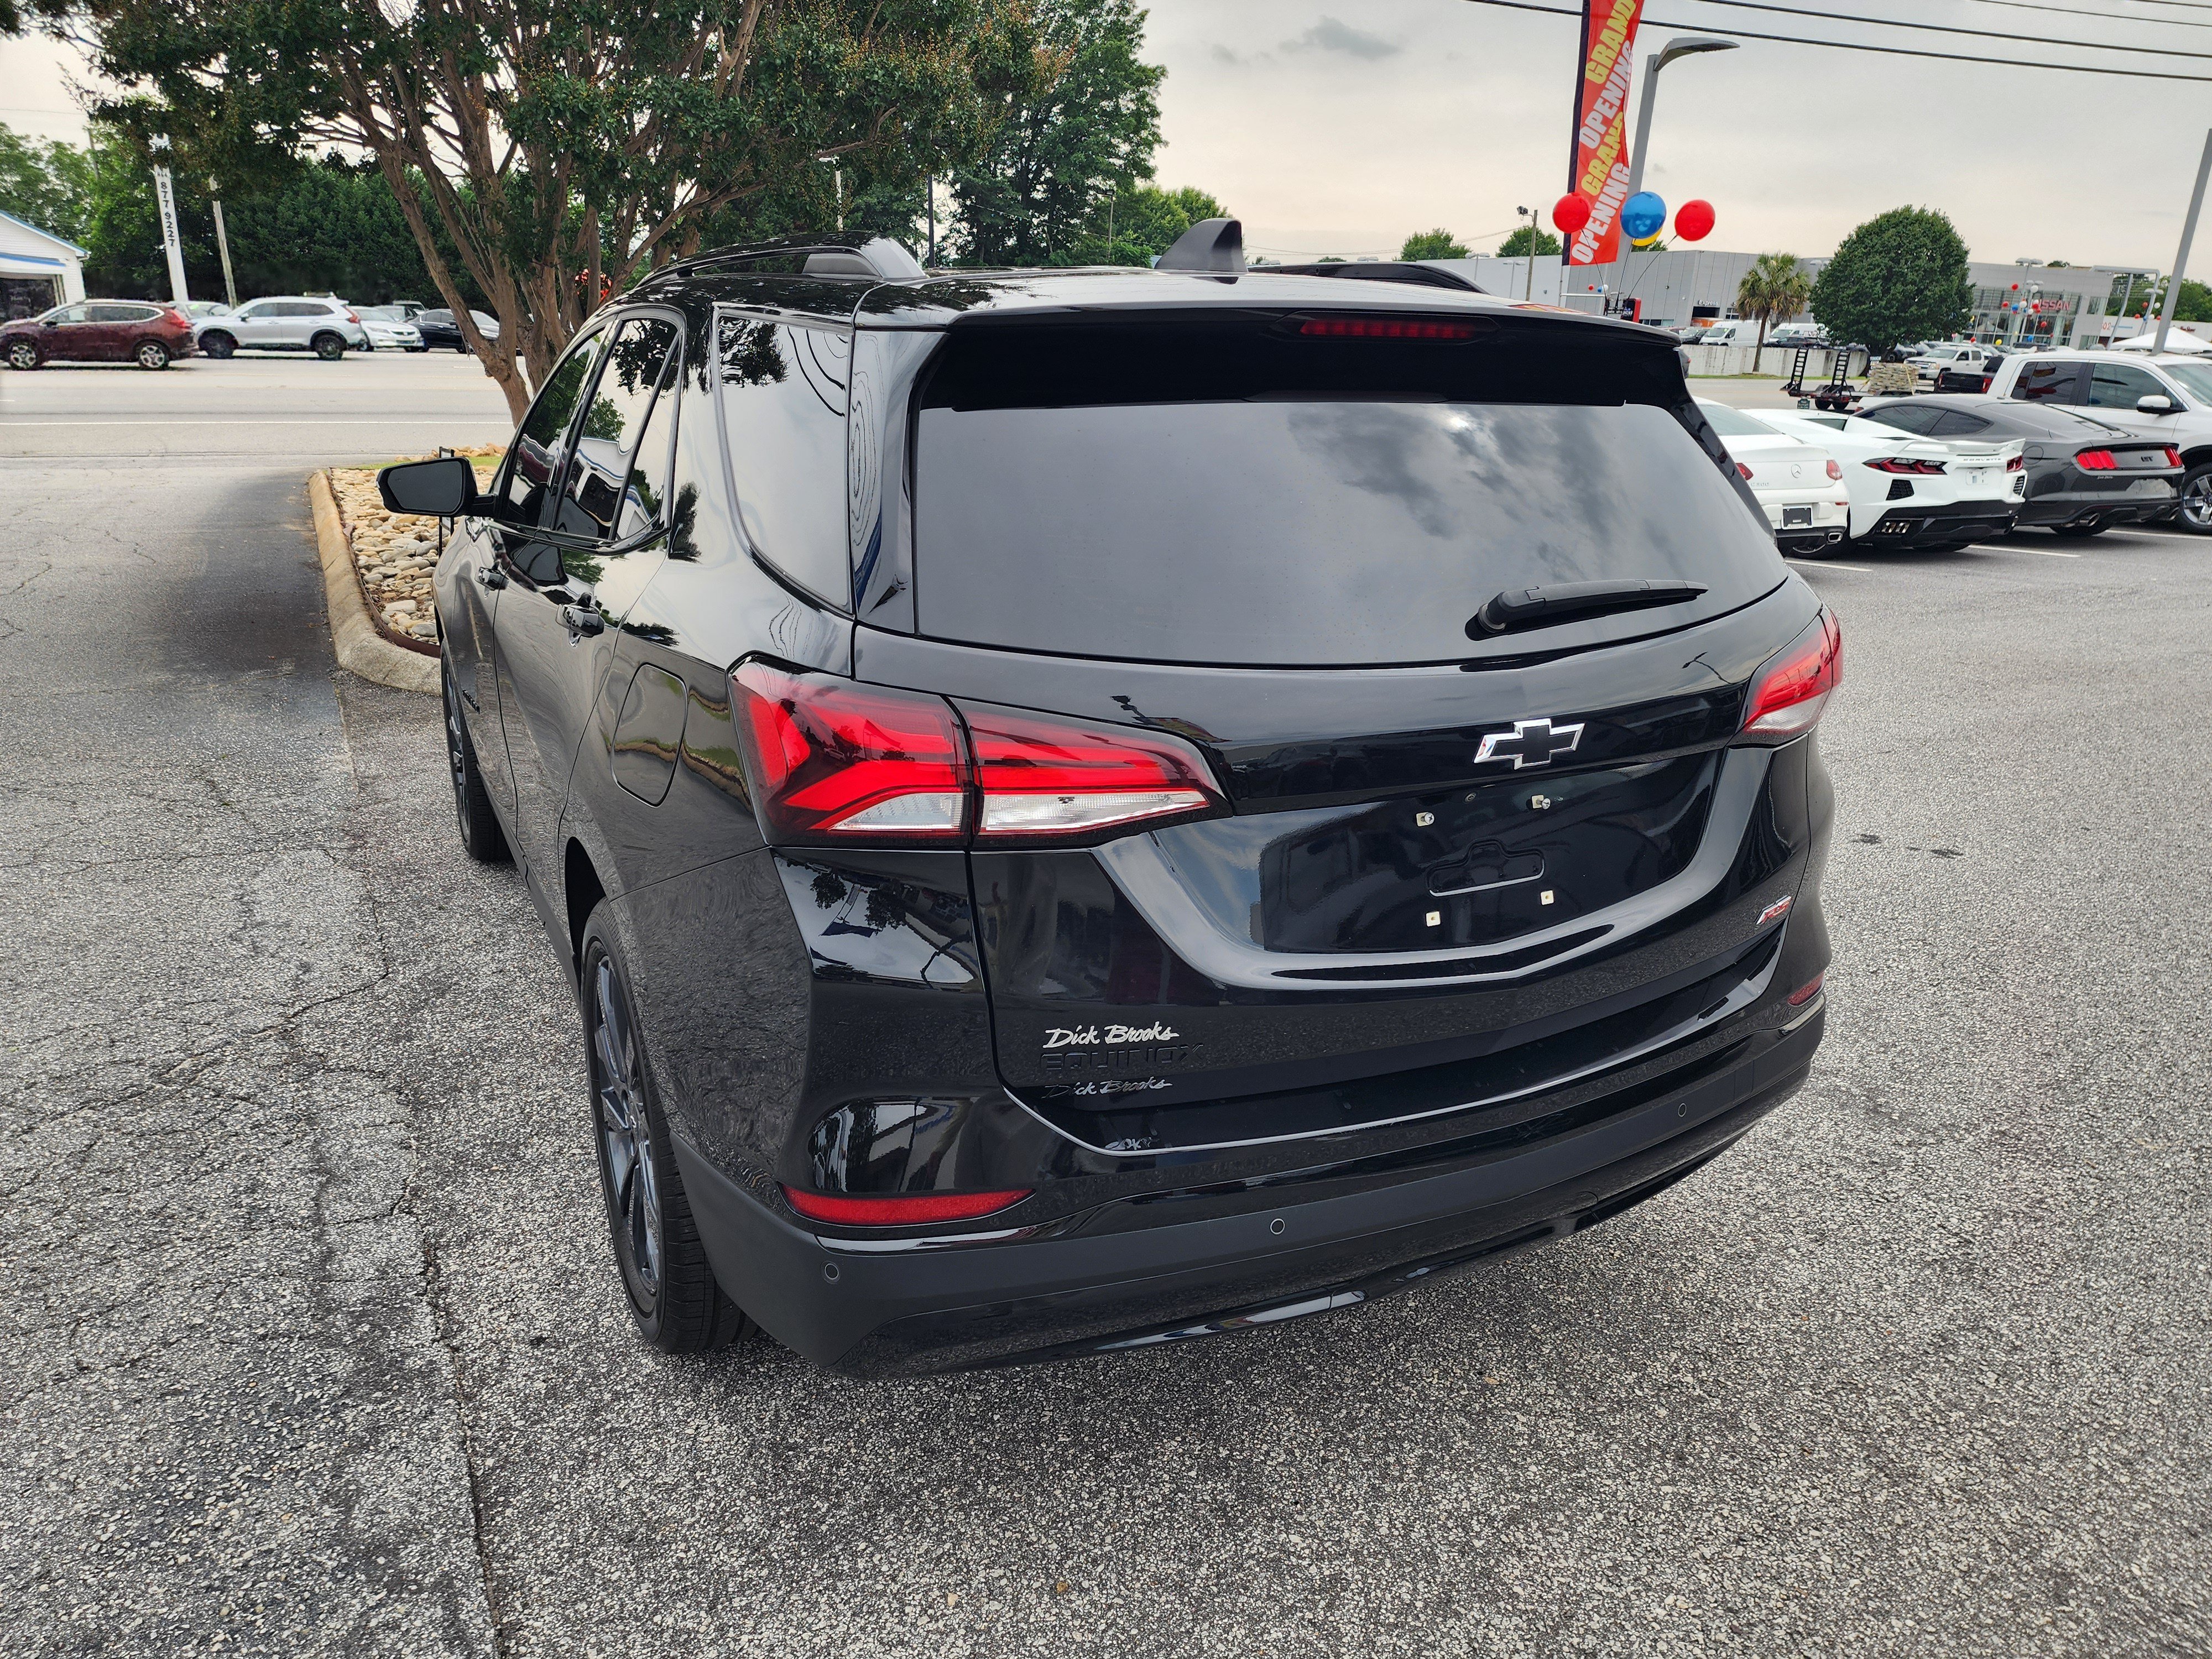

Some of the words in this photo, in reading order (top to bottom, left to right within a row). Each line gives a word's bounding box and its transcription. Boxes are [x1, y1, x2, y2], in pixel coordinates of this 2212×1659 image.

[1585, 0, 1636, 84] GRAND
[1572, 163, 1630, 264] OPENING
[1757, 896, 1792, 925] RS
[1042, 1025, 1100, 1048] Dick
[1104, 1021, 1180, 1044] Brooks
[1039, 1044, 1204, 1070] EQUINOX
